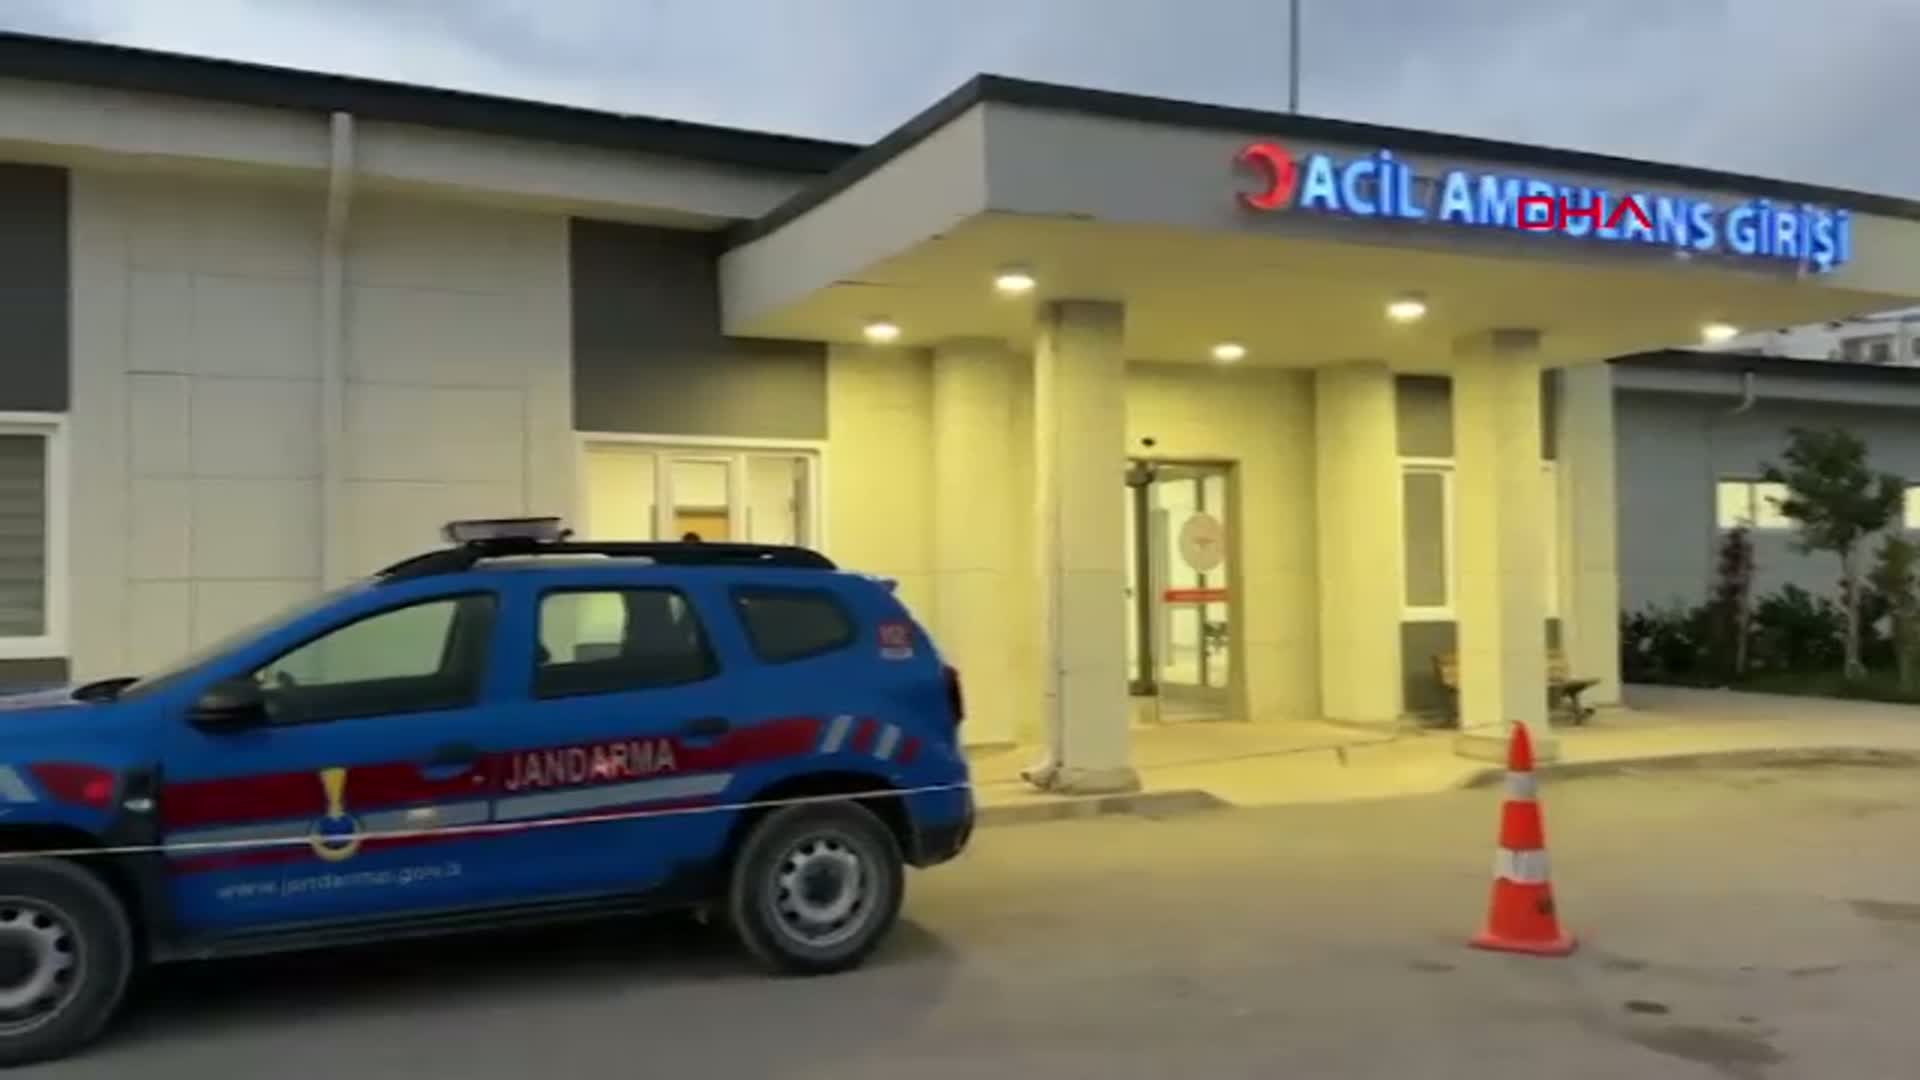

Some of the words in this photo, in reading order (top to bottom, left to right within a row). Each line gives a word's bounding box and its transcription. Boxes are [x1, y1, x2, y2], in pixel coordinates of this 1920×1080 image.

[1301, 149, 1425, 218] ACİL
[1726, 199, 1851, 272] GİRİŞİ
[505, 738, 676, 791] JANDARMA
